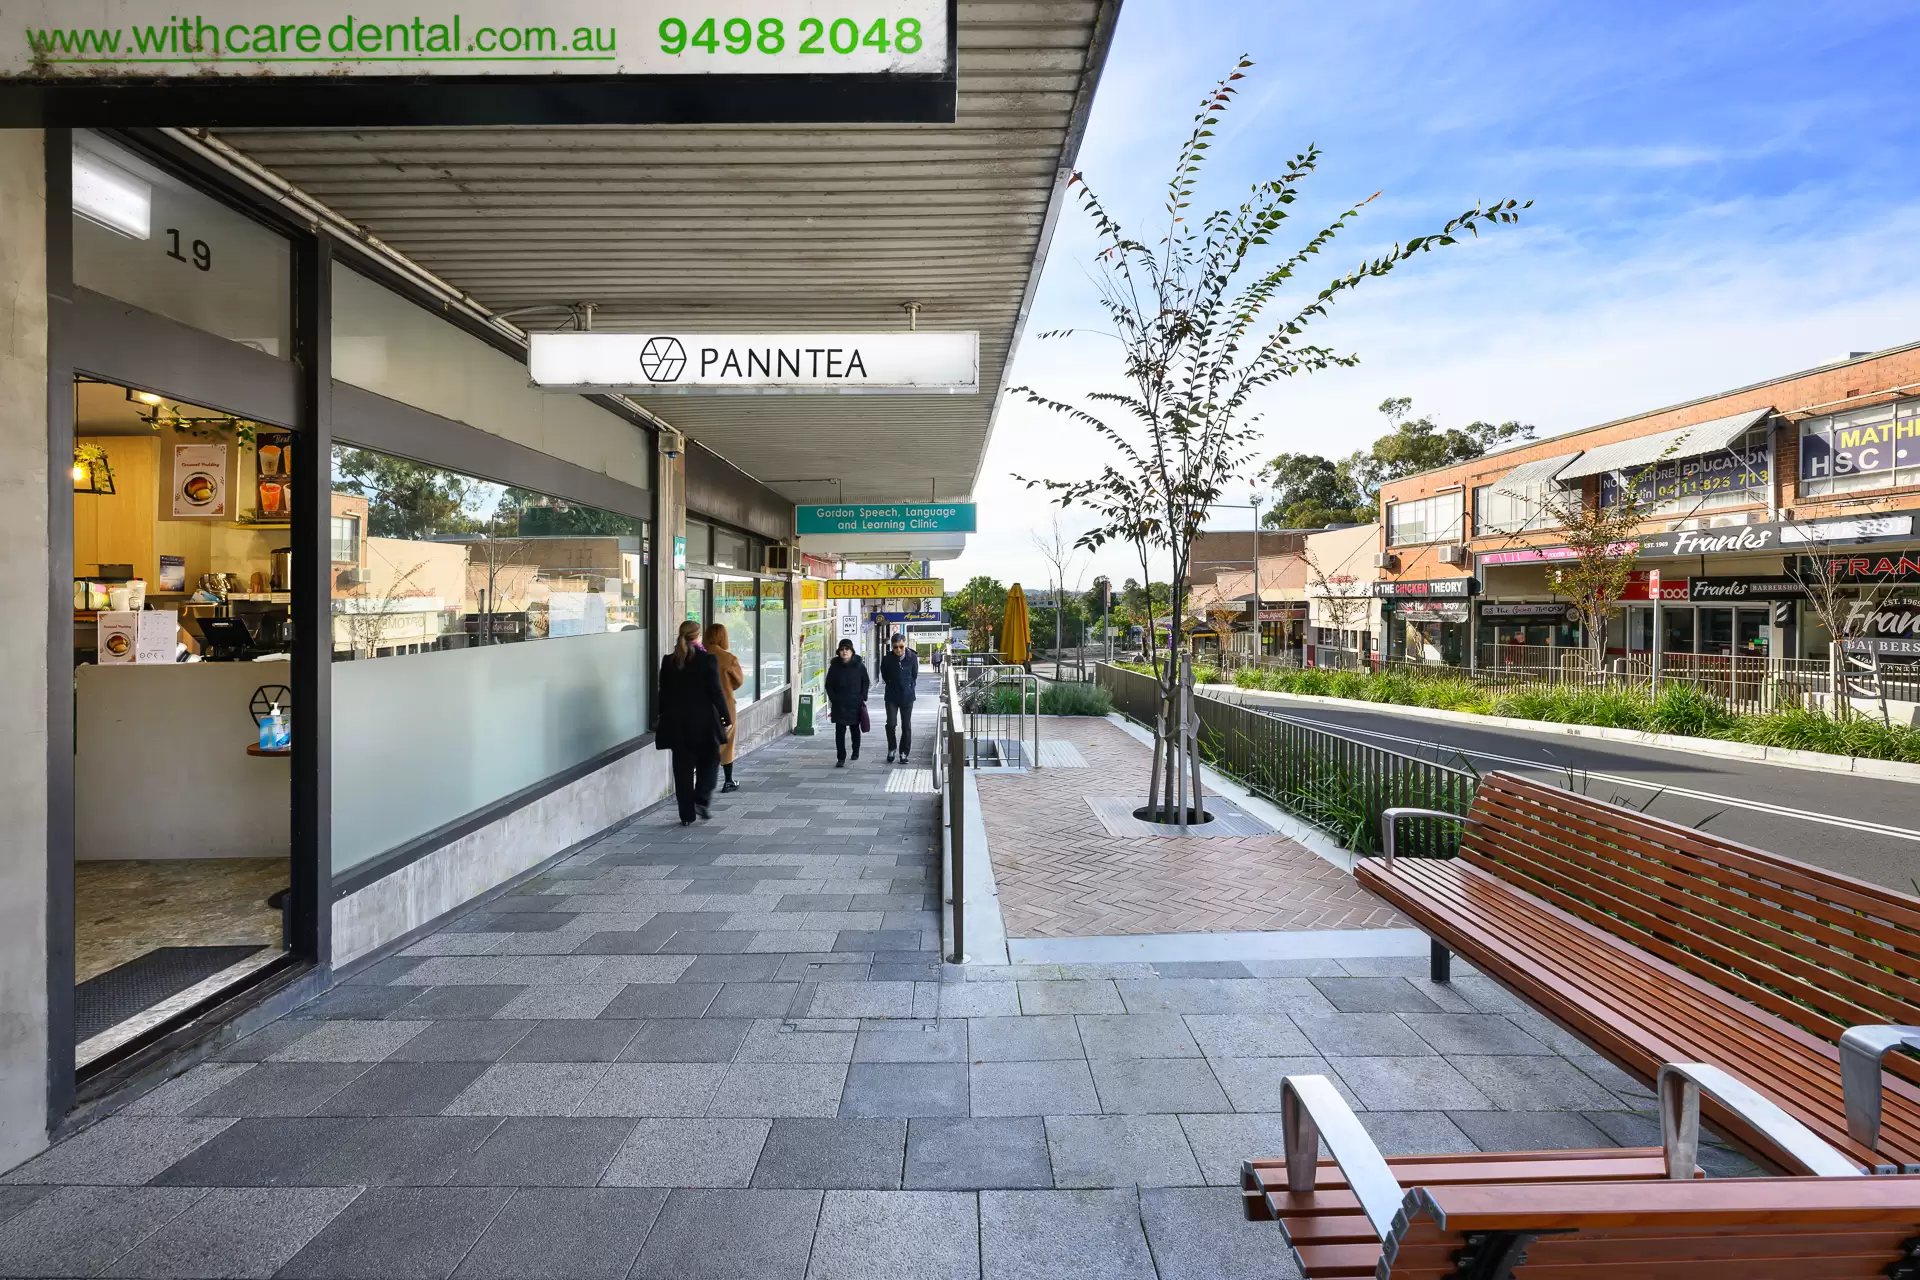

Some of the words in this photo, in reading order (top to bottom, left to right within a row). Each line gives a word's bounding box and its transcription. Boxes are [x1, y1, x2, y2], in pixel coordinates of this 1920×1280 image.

[658, 17, 785, 54] 9498
[799, 17, 922, 54] 2048
[166, 228, 211, 272] 19
[700, 348, 868, 378] PANNTEA
[1841, 418, 1920, 449] MATH
[1683, 450, 1768, 476] EDUCATION
[1812, 448, 1880, 477] HSC
[1703, 476, 1731, 491] 825
[816, 507, 855, 519] Gordon
[859, 507, 901, 520] Speech,
[905, 507, 956, 519] Language
[837, 519, 857, 530] and
[862, 519, 906, 531] Learning
[910, 519, 938, 529] Clinic
[1672, 526, 1772, 556] Franks
[833, 582, 881, 597] CURRY
[887, 585, 935, 596] MONITOR
[1381, 583, 1395, 594] THE
[1395, 583, 1428, 593] CHICKEN
[1430, 582, 1462, 593] THEORY
[1693, 580, 1748, 597] Franks
